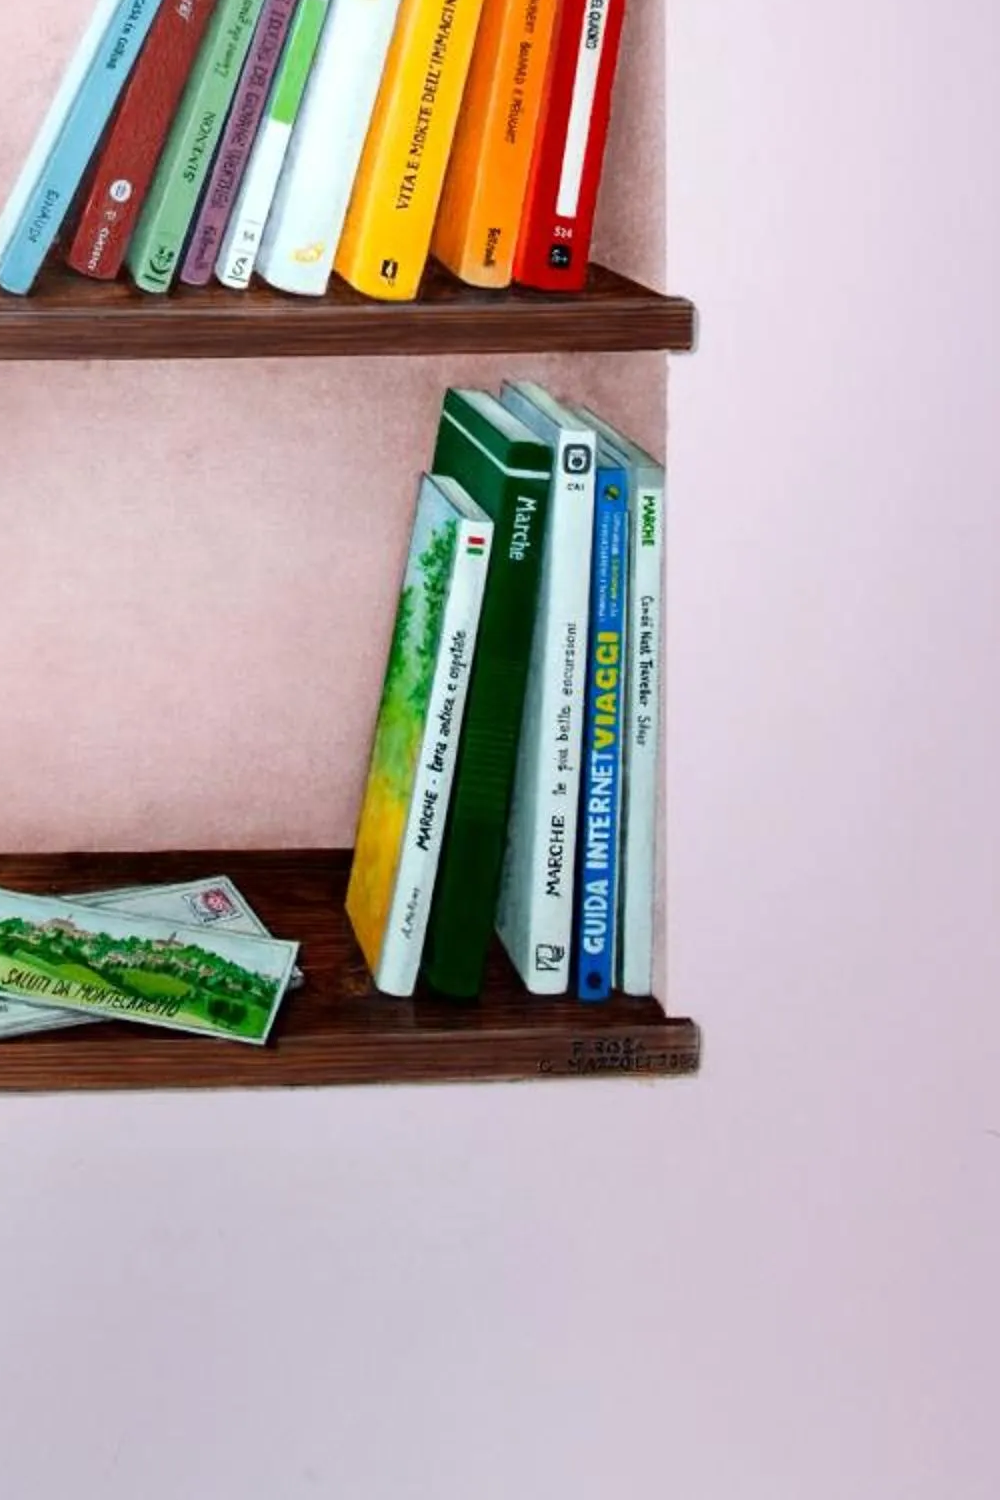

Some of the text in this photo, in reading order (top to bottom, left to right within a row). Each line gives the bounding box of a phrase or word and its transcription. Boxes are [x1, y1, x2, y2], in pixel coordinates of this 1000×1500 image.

[408, 105, 432, 156] MORTE
[395, 174, 417, 209] VITA
[406, 161, 418, 171] E
[508, 495, 536, 560] Marche
[641, 495, 656, 546] MARCHE
[551, 782, 566, 795] le
[415, 789, 438, 851] MARCHE
[545, 815, 565, 897] MARCHE
[582, 878, 609, 954] GUIDA
[2, 967, 51, 992] SALUTI
[52, 980, 71, 995] DA
